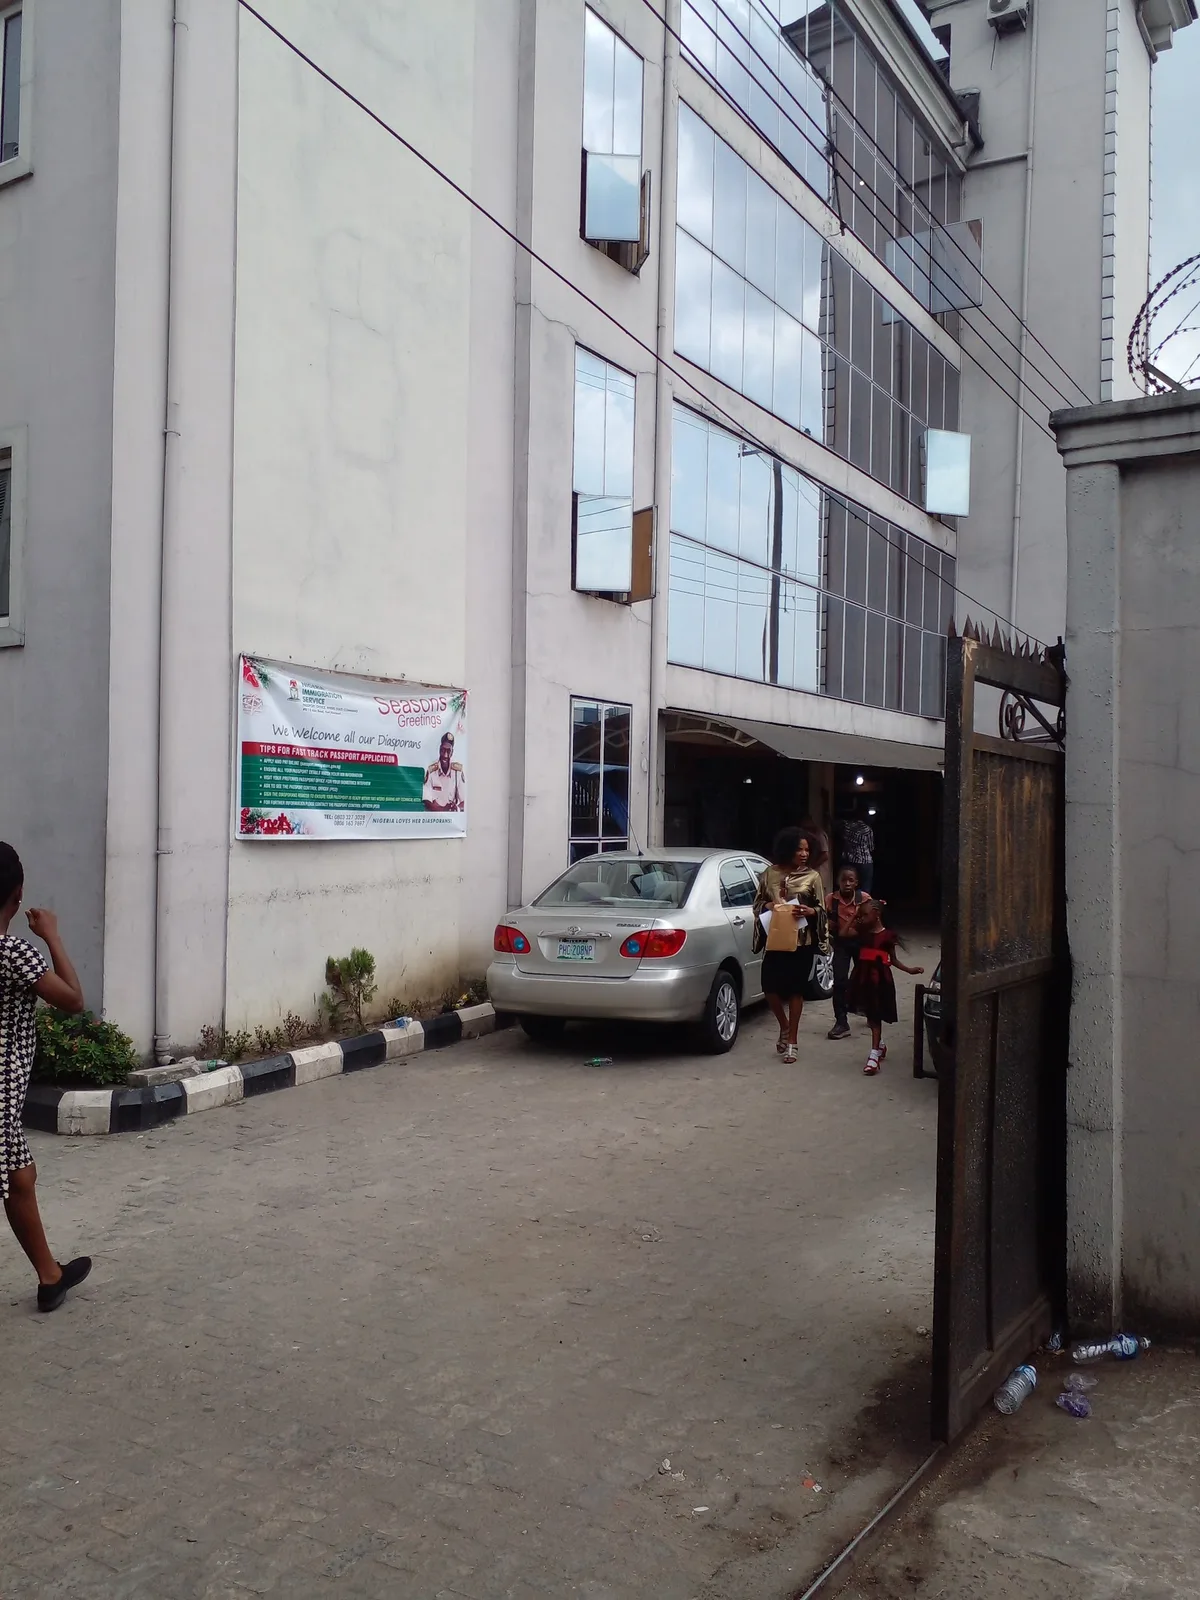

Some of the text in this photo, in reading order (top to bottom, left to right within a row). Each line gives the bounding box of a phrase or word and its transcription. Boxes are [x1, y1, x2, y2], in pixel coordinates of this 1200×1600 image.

[301, 688, 343, 700] IMMIGRATION
[302, 696, 326, 705] SERVICE
[373, 696, 448, 716] Seasons
[397, 713, 442, 728] Greetings
[272, 723, 422, 751] We Welcome all our Diasporans
[259, 744, 276, 754] TIPS
[277, 746, 291, 755] FOR
[307, 749, 329, 759] TRACK
[329, 751, 360, 761] PASSPORT
[360, 753, 396, 764] APPLICATION
